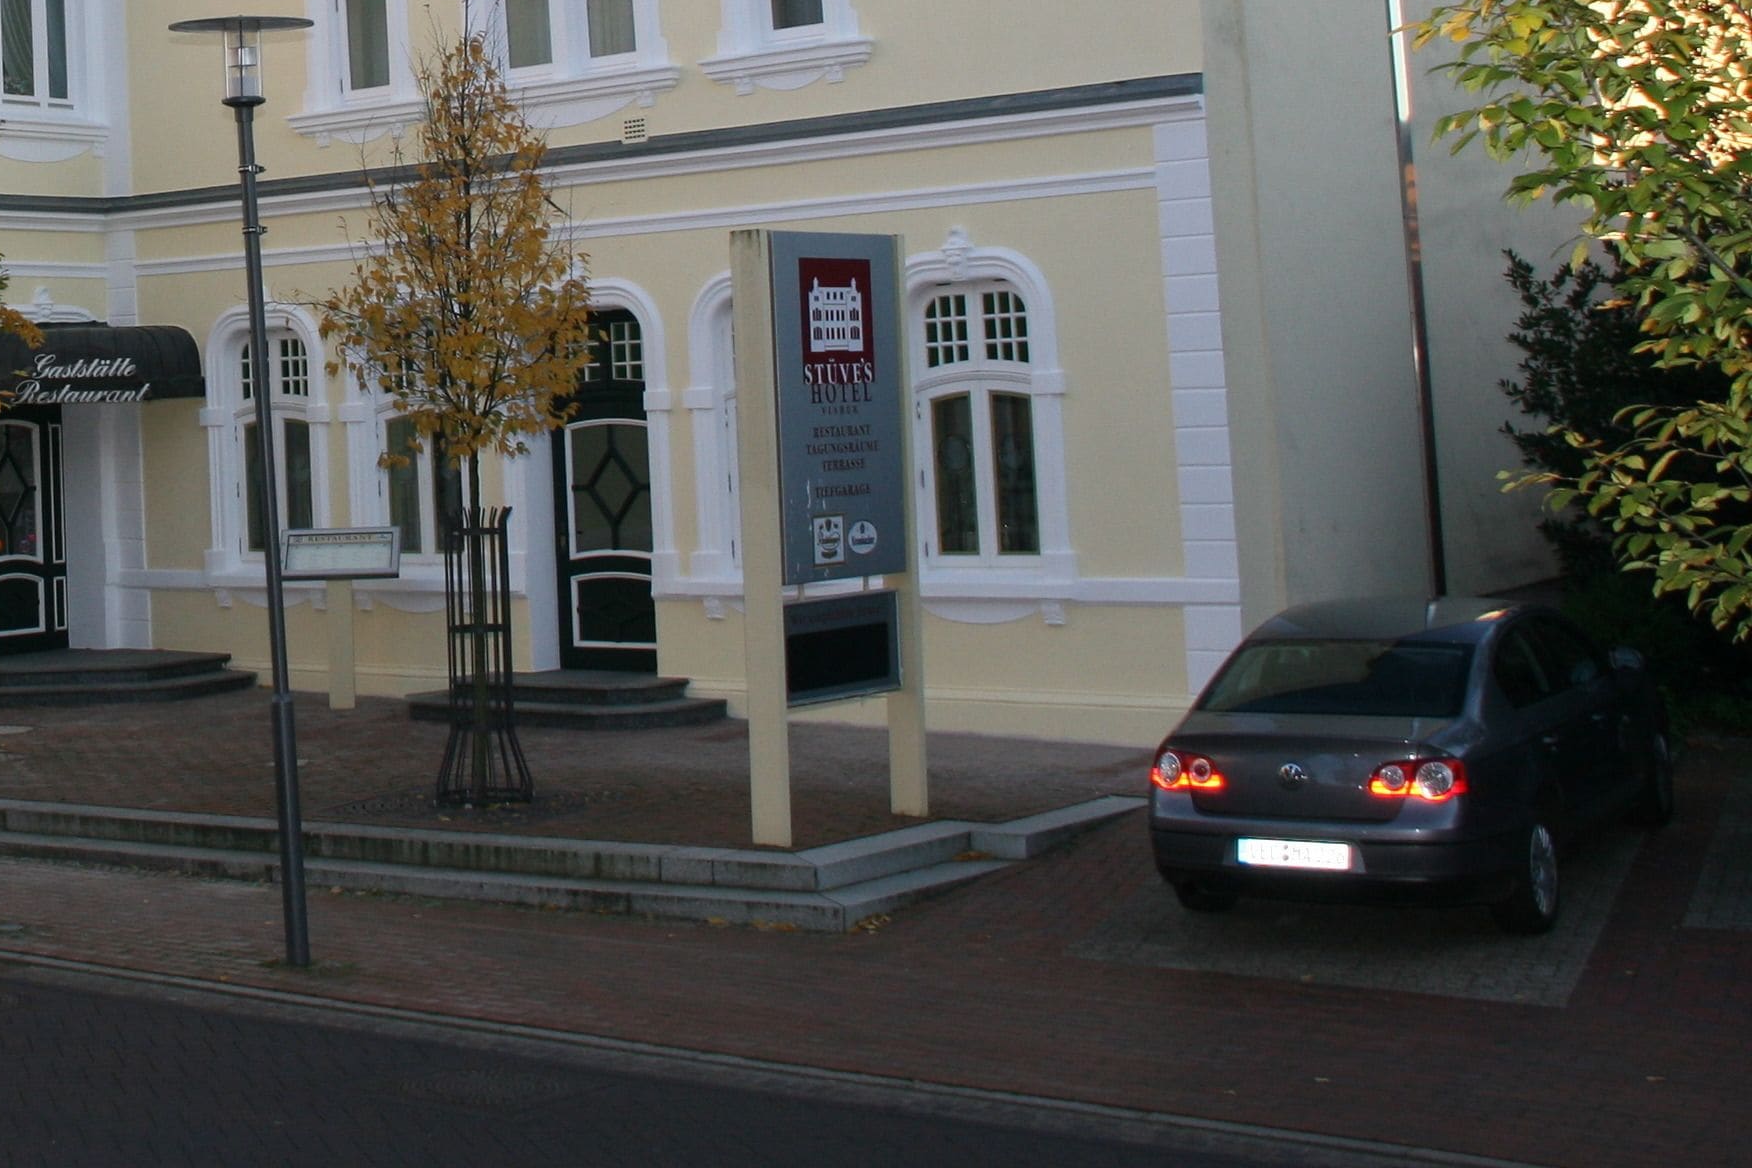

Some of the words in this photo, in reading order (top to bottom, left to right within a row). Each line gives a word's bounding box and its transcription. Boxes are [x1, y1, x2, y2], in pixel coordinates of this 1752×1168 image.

[32, 353, 136, 379] Gaststätte
[10, 379, 150, 404] Restaurant
[811, 382, 873, 404] HOTEL
[812, 424, 872, 439] RESTAURANT
[806, 439, 880, 456] TAGUNGSRÄUME
[822, 458, 865, 472] TERRASSE
[815, 483, 871, 498] TIEFGARAGE
[308, 534, 372, 542] RESTAURANT
